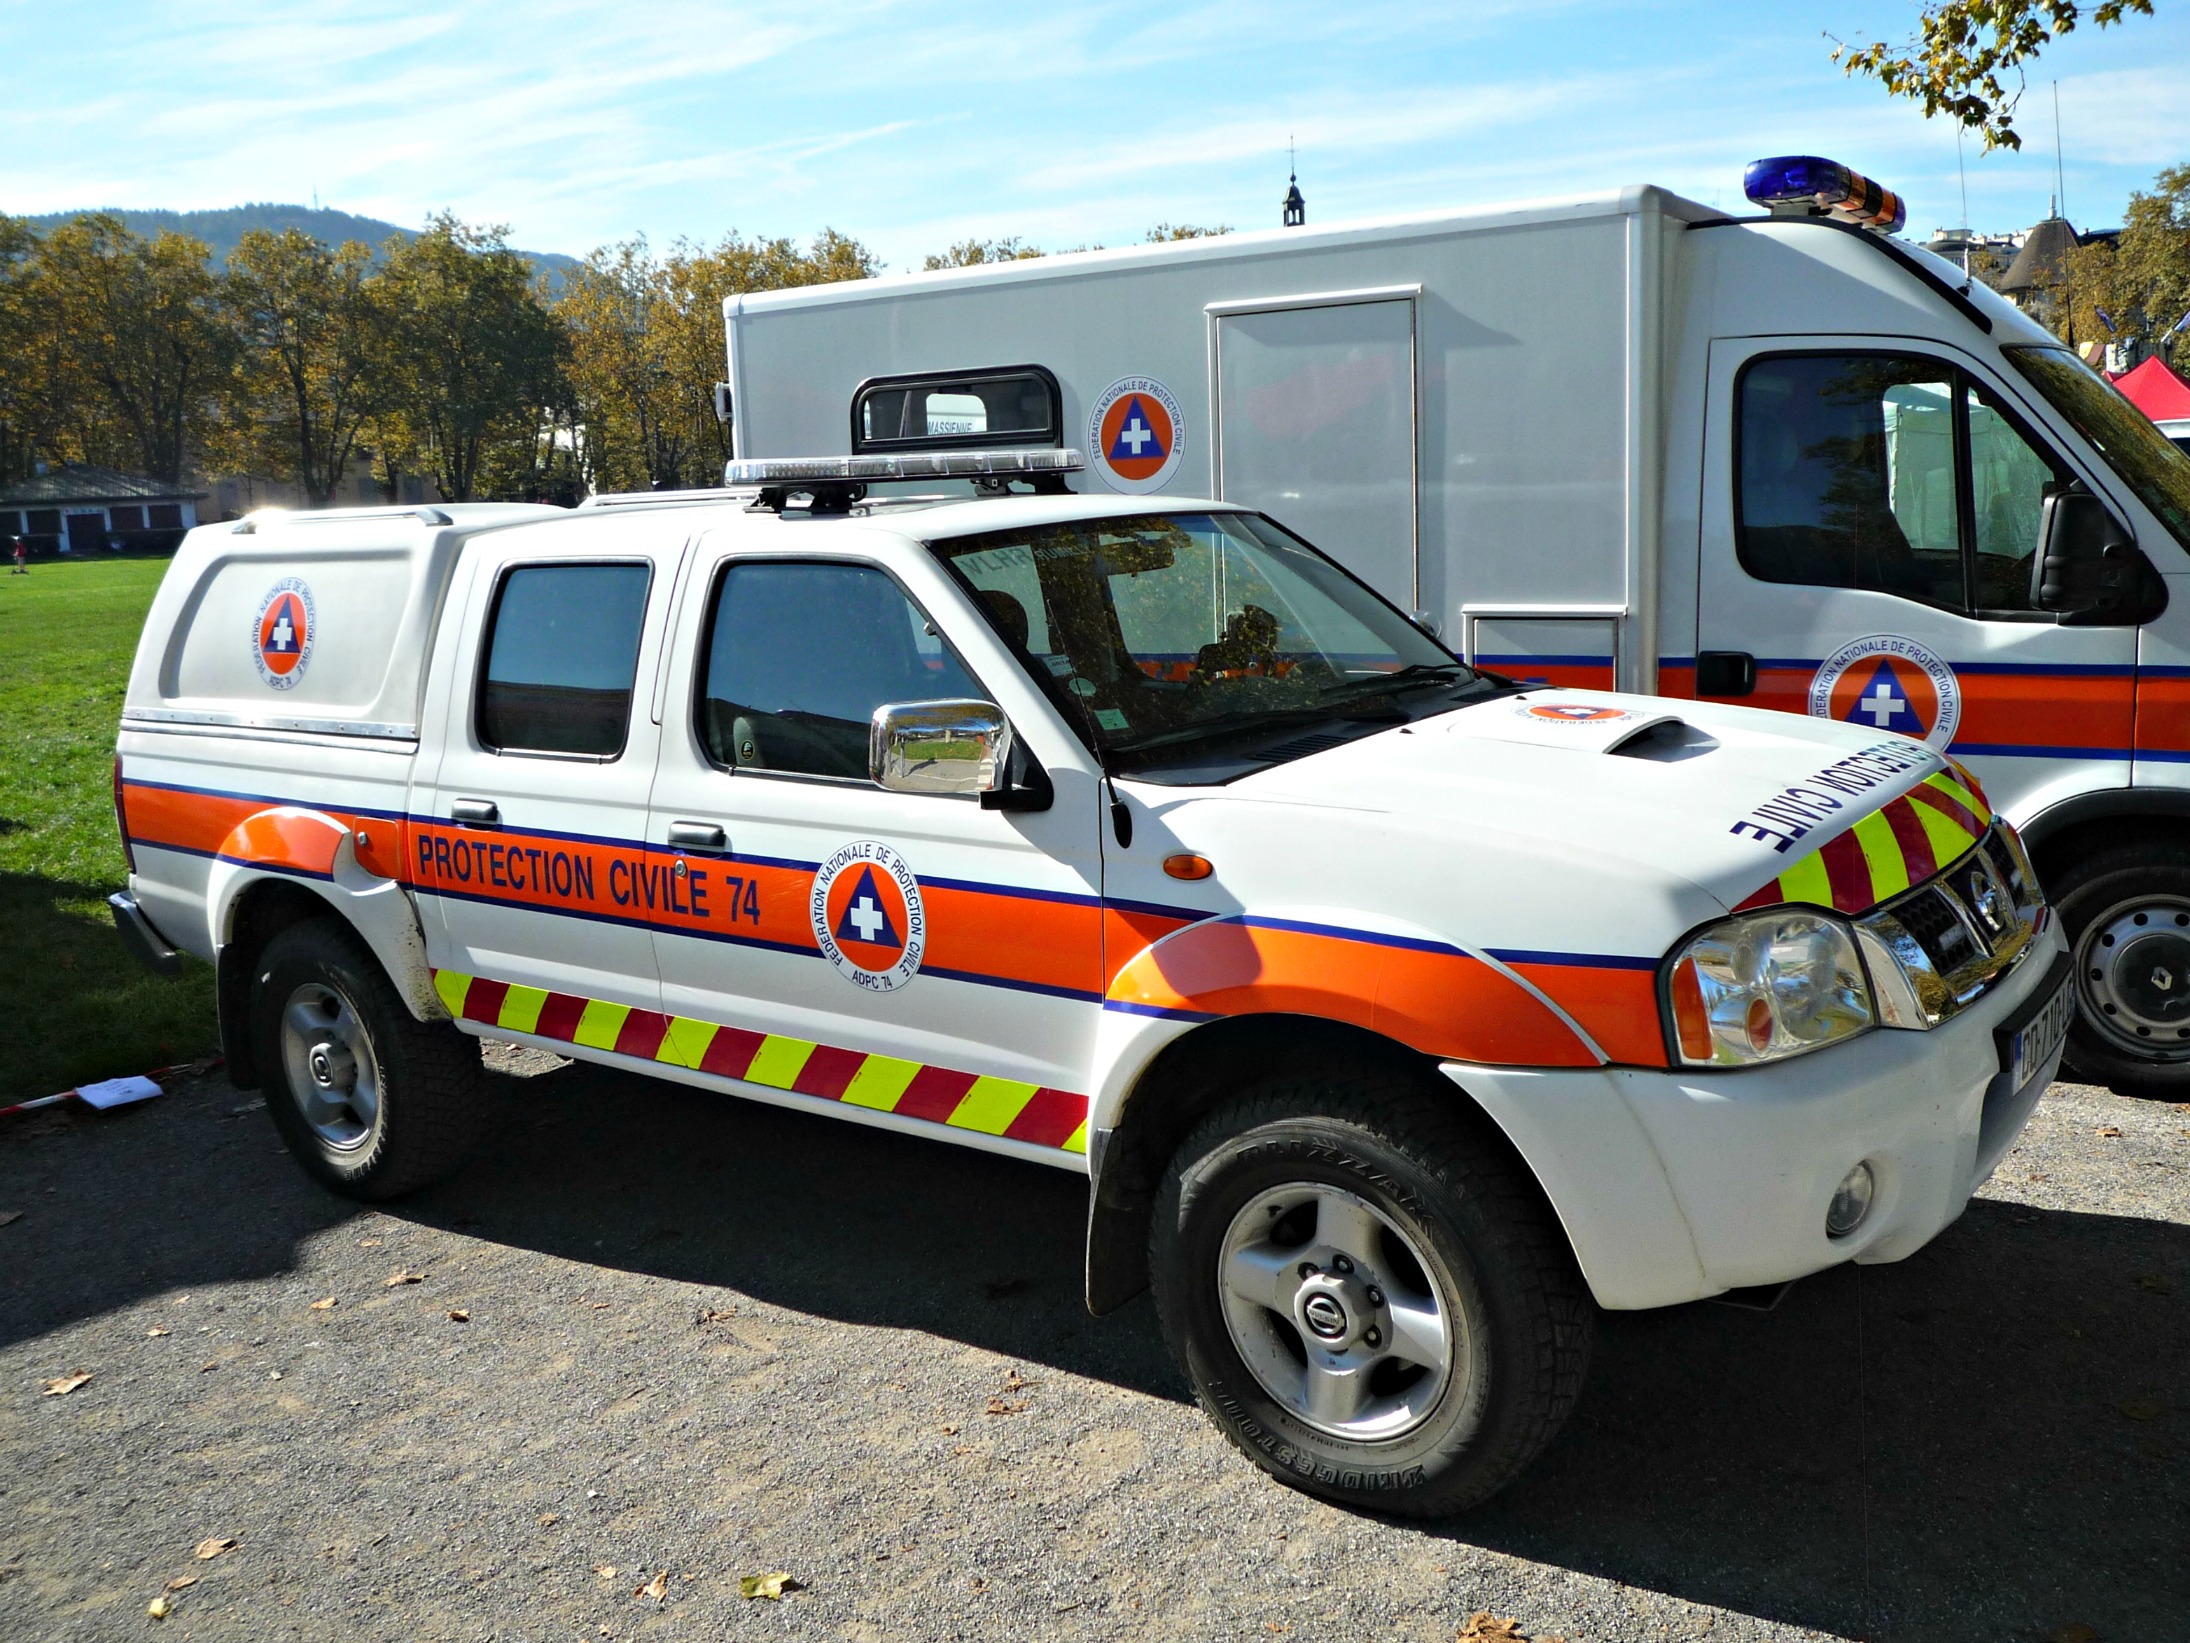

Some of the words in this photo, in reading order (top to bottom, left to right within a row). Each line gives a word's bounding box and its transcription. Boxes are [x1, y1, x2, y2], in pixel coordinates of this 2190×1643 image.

[1091, 408, 1105, 460] FEDERATION
[1101, 381, 1137, 408] NATIONALE
[1138, 380, 1148, 391] DE
[1148, 383, 1182, 426] PROTECTION
[1172, 428, 1183, 455] CIVILE
[252, 616, 266, 674] FEDERATION
[1815, 666, 1838, 720] DERATION
[1834, 640, 1888, 669] NATIONALE
[1890, 640, 1905, 653] DE
[1906, 645, 1952, 699] PROTECTION
[1937, 701, 1953, 733] CIVILE
[418, 833, 595, 901] PROTECTION
[609, 859, 710, 918] CIVILE
[726, 875, 761, 926] 74
[820, 844, 871, 886] NATIONALE
[876, 847, 891, 864] DE
[813, 888, 844, 967] FEDERATION
[891, 859, 922, 936] PROTECTION
[852, 970, 879, 989] ADPC
[881, 975, 893, 990] 74
[899, 941, 921, 977] CIVILE
